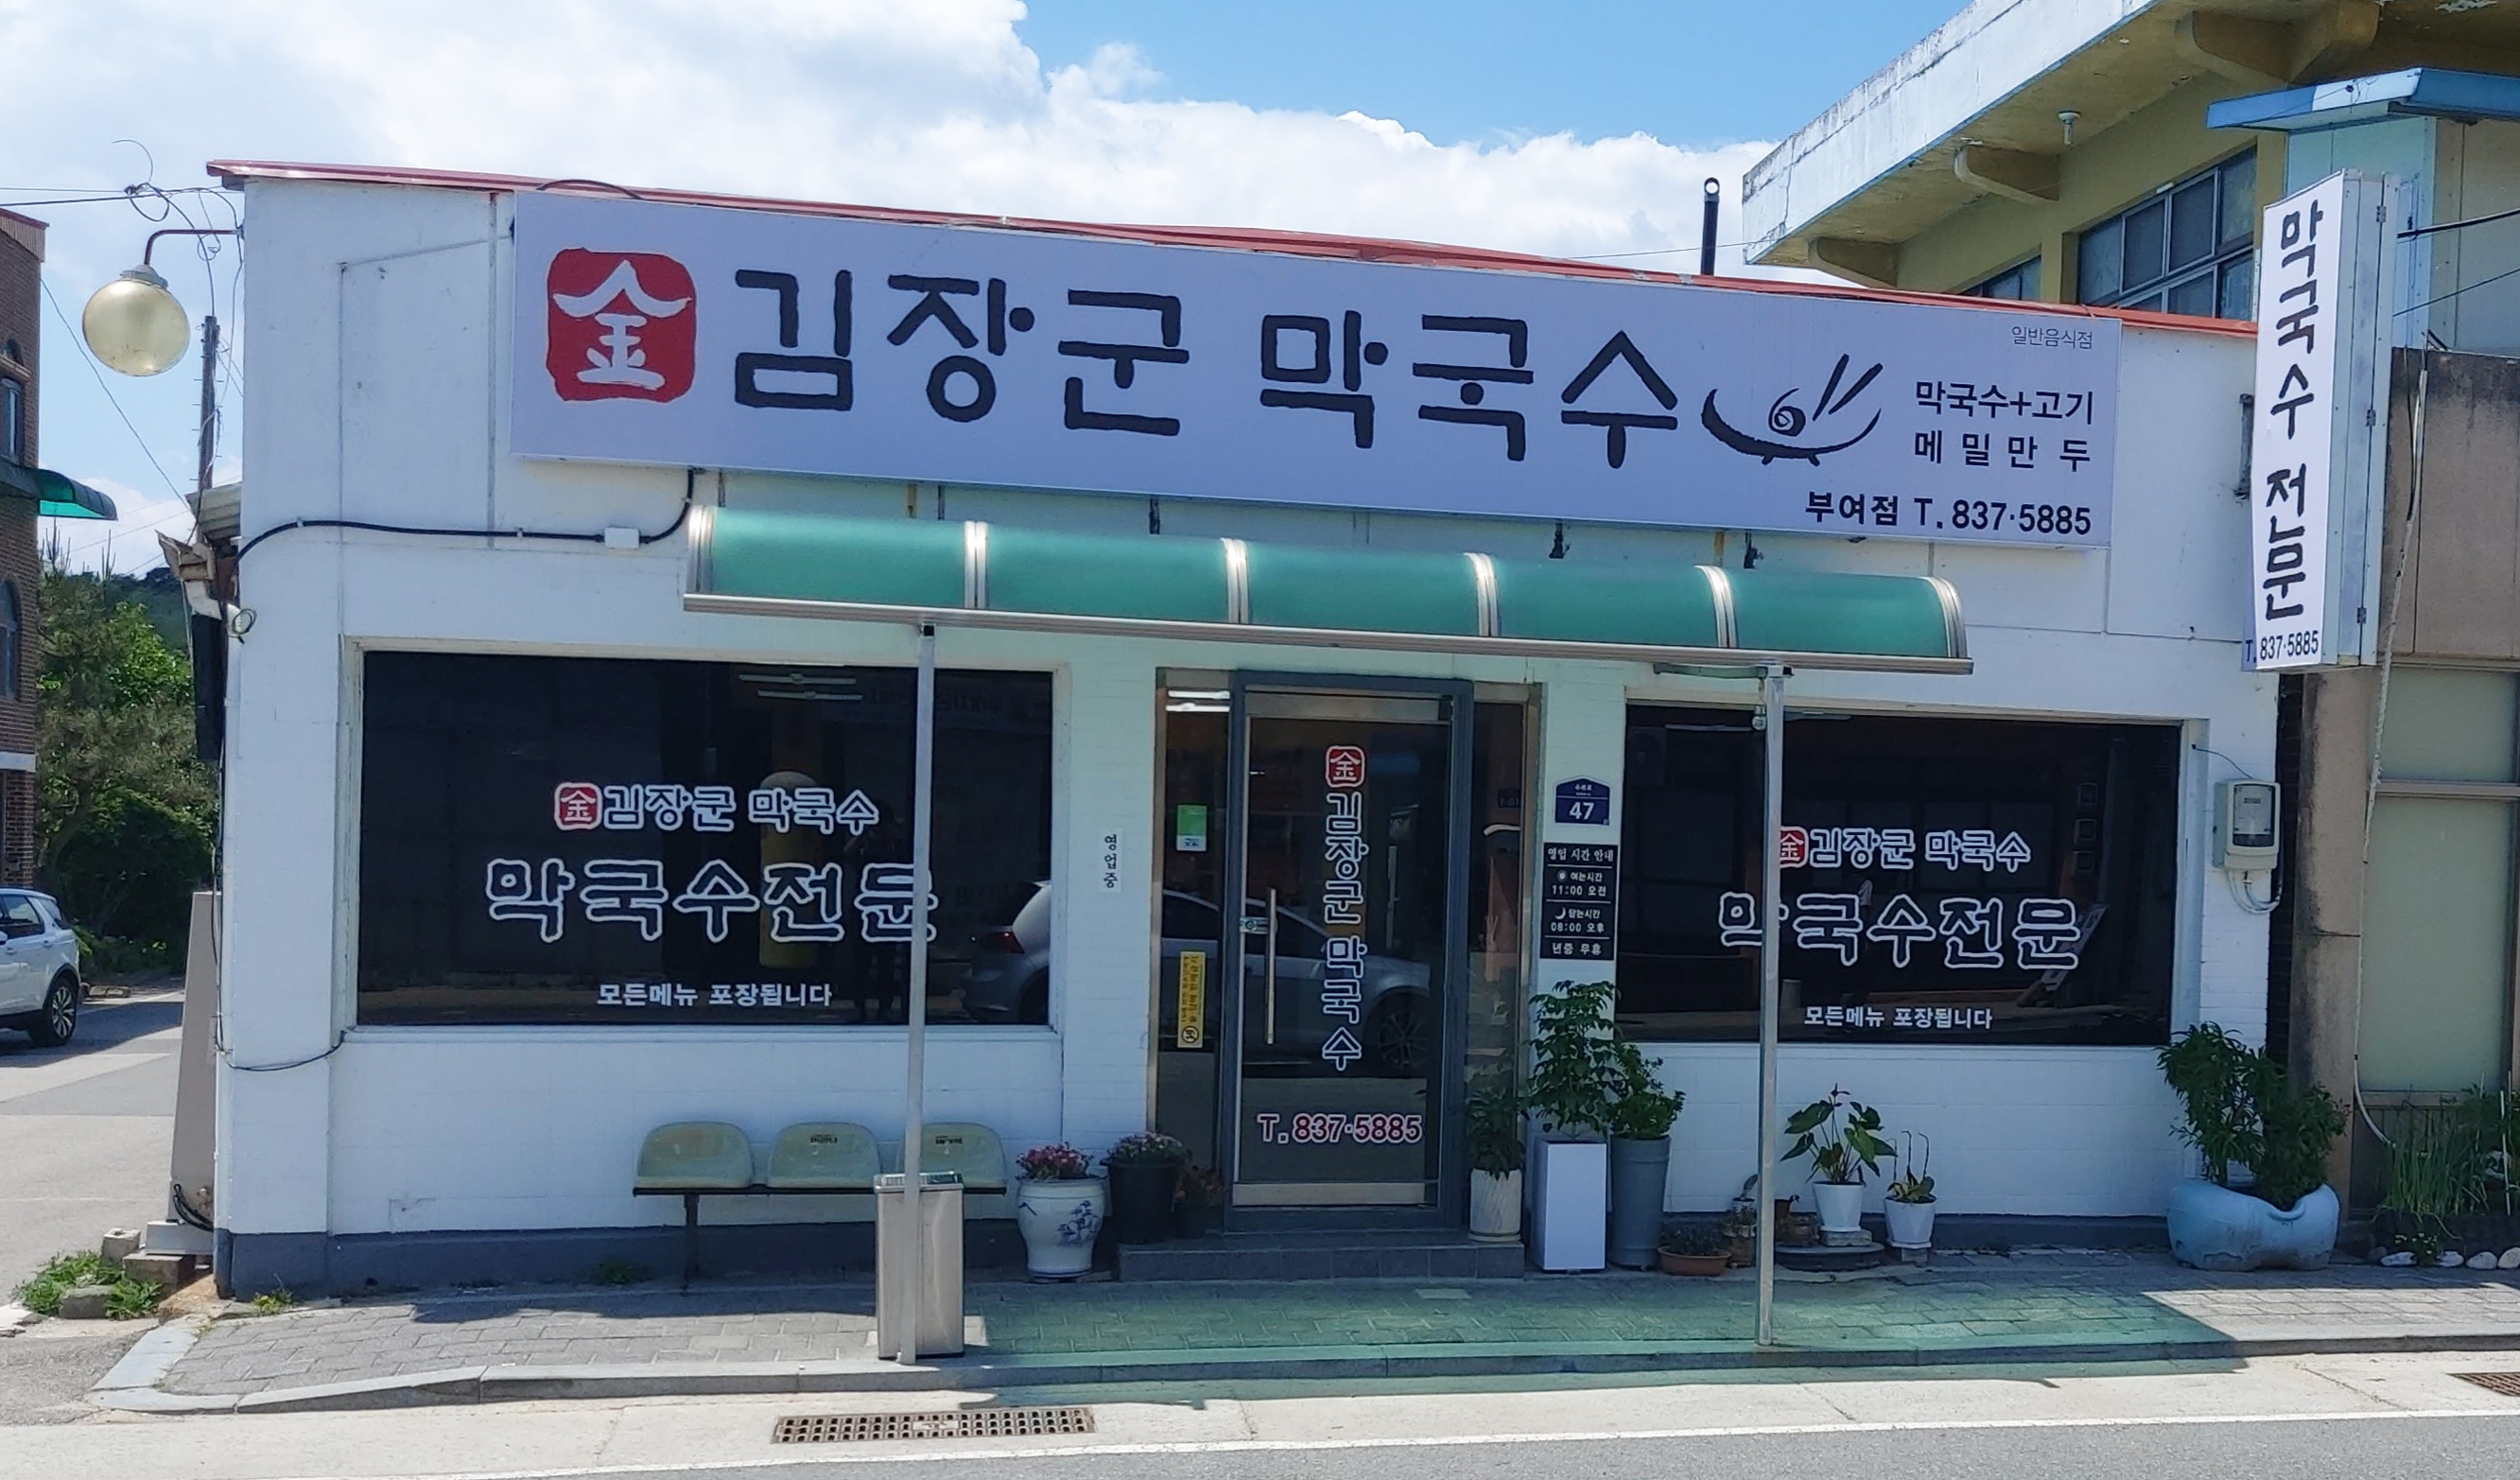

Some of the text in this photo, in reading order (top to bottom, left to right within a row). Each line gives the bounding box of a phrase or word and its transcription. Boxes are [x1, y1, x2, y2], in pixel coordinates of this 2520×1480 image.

[2011, 324, 2094, 349] 일반음식점
[553, 260, 1678, 469] 金 김장군 막국수
[1916, 380, 2094, 425] 막국수+고기
[2263, 199, 2322, 621] 막국수 전문
[1805, 492, 1901, 527] 부여점
[557, 784, 880, 835] 金 김장군 막국수
[1569, 801, 1595, 821] 47
[1104, 833, 1118, 889] 영업중
[1548, 847, 1614, 862] 영업 시간 안내
[1809, 828, 1917, 870] 김장군
[1923, 830, 2032, 873] 막국수
[484, 858, 939, 944] 막국수전문
[1552, 884, 1583, 896] 11:00
[1321, 748, 1369, 1072] 金 김장군 막국수
[1551, 922, 1582, 932] 08:00
[1552, 943, 1573, 955] 년중
[597, 983, 833, 1007] 모든메뉴 포장됩니다
[1803, 1006, 1993, 1030] 모든메뉴 포장됩니다
